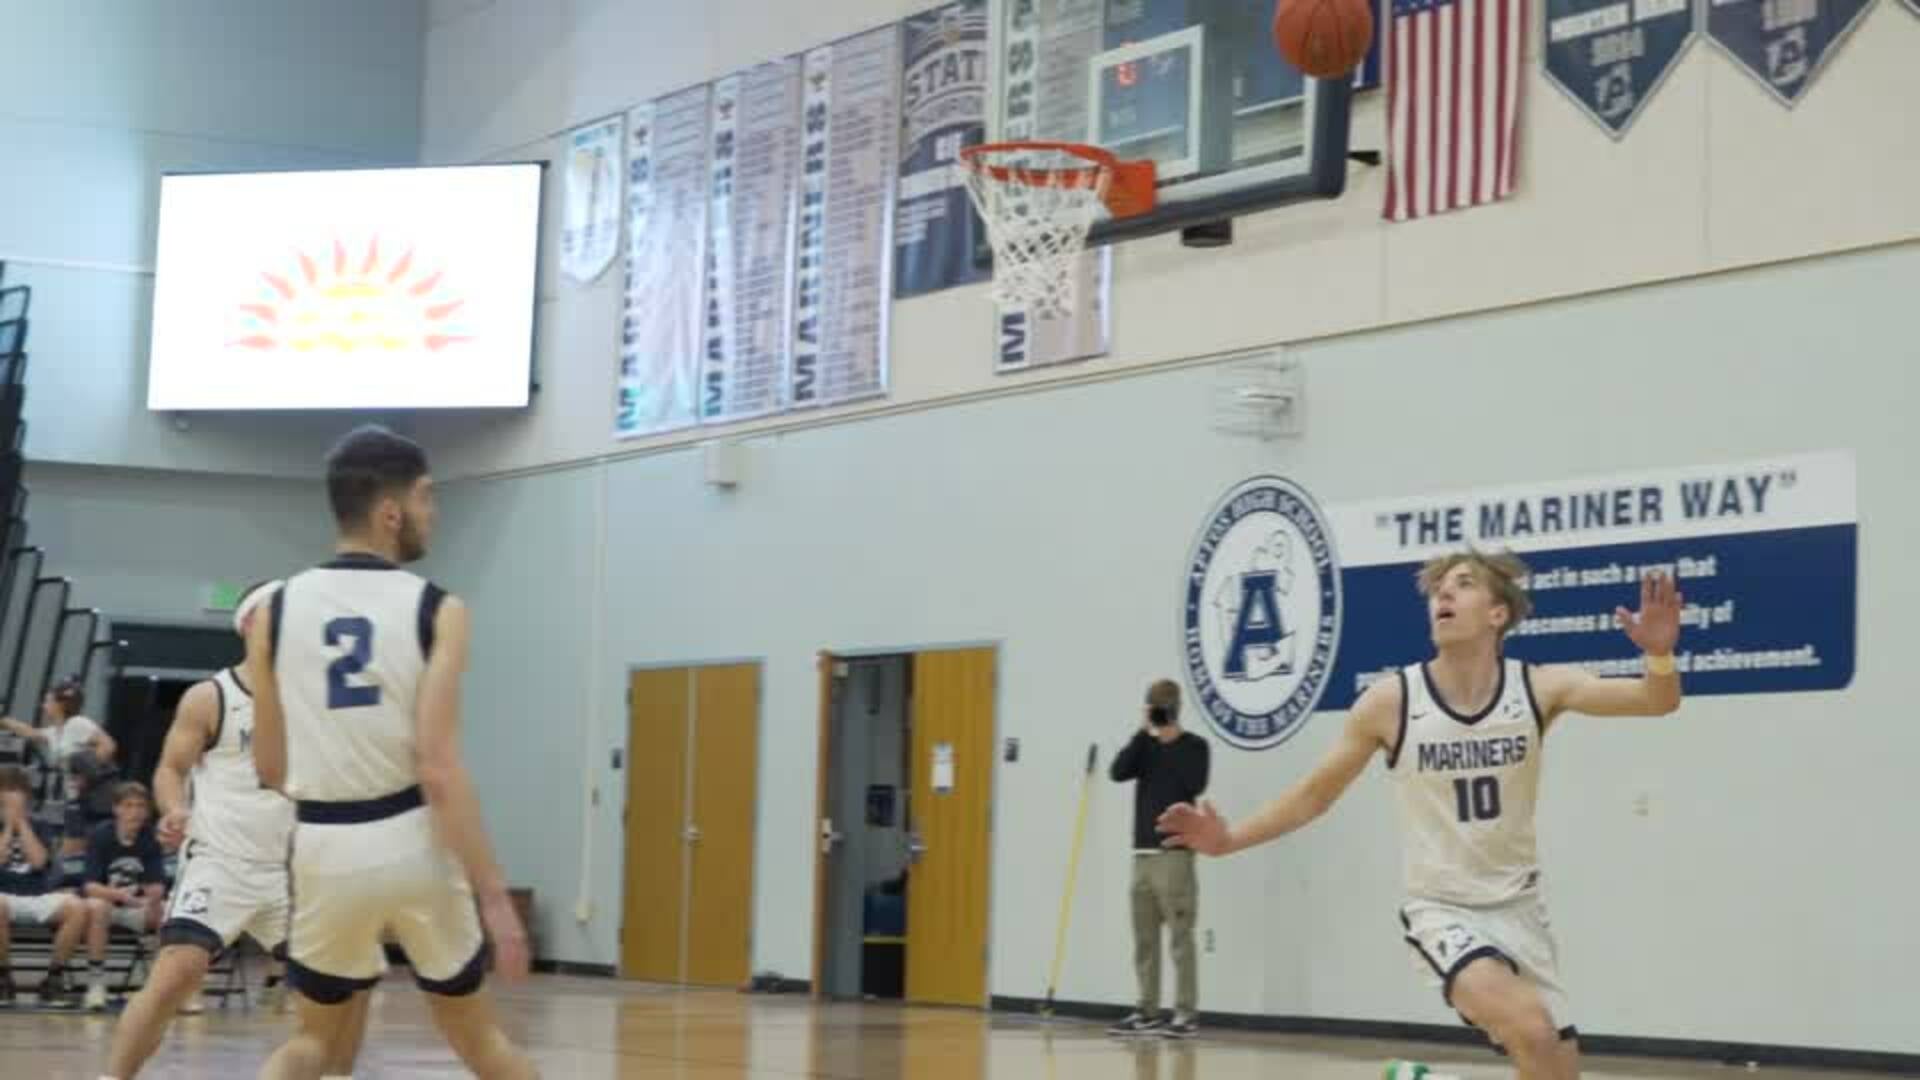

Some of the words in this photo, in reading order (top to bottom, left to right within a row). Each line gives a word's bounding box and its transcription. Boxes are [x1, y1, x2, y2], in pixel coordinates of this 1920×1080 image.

[906, 49, 986, 108] STAT
[704, 130, 734, 416] MARINRS
[1479, 487, 1663, 539] MARINER
[1580, 562, 1623, 586] such
[1677, 555, 1717, 578] that
[1712, 599, 1734, 623] of
[324, 615, 381, 710] 2
[1416, 735, 1528, 775] MARINERS
[1452, 774, 1502, 823] 10
